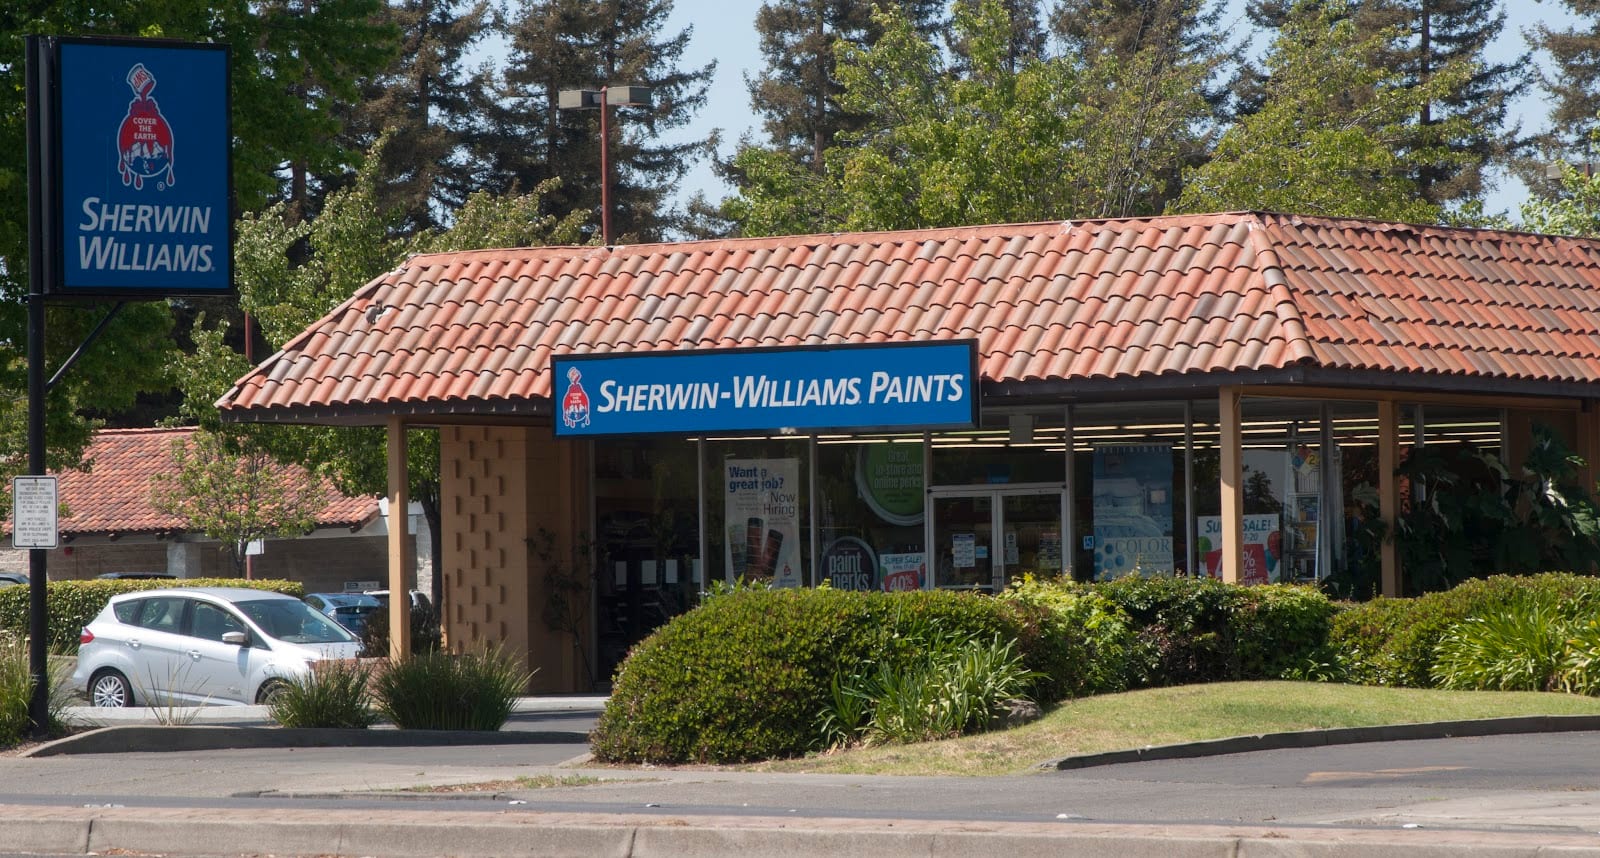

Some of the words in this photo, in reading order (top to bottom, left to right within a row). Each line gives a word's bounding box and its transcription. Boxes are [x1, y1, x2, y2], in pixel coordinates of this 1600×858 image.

[132, 117, 157, 125] COVER
[139, 125, 152, 133] THE
[79, 196, 212, 234] SHERWIN
[78, 235, 213, 273] WILLIAMS
[868, 370, 964, 405] PAINTS
[1310, 455, 1316, 465] 2
[729, 466, 758, 478] Want
[729, 478, 758, 493] great
[761, 477, 784, 492] job?
[770, 492, 795, 502] Now
[763, 503, 795, 518] Hiring
[1243, 519, 1271, 531] SALE!
[1115, 538, 1172, 553] COLOR
[828, 551, 862, 576] paint
[884, 556, 903, 565] SUPER
